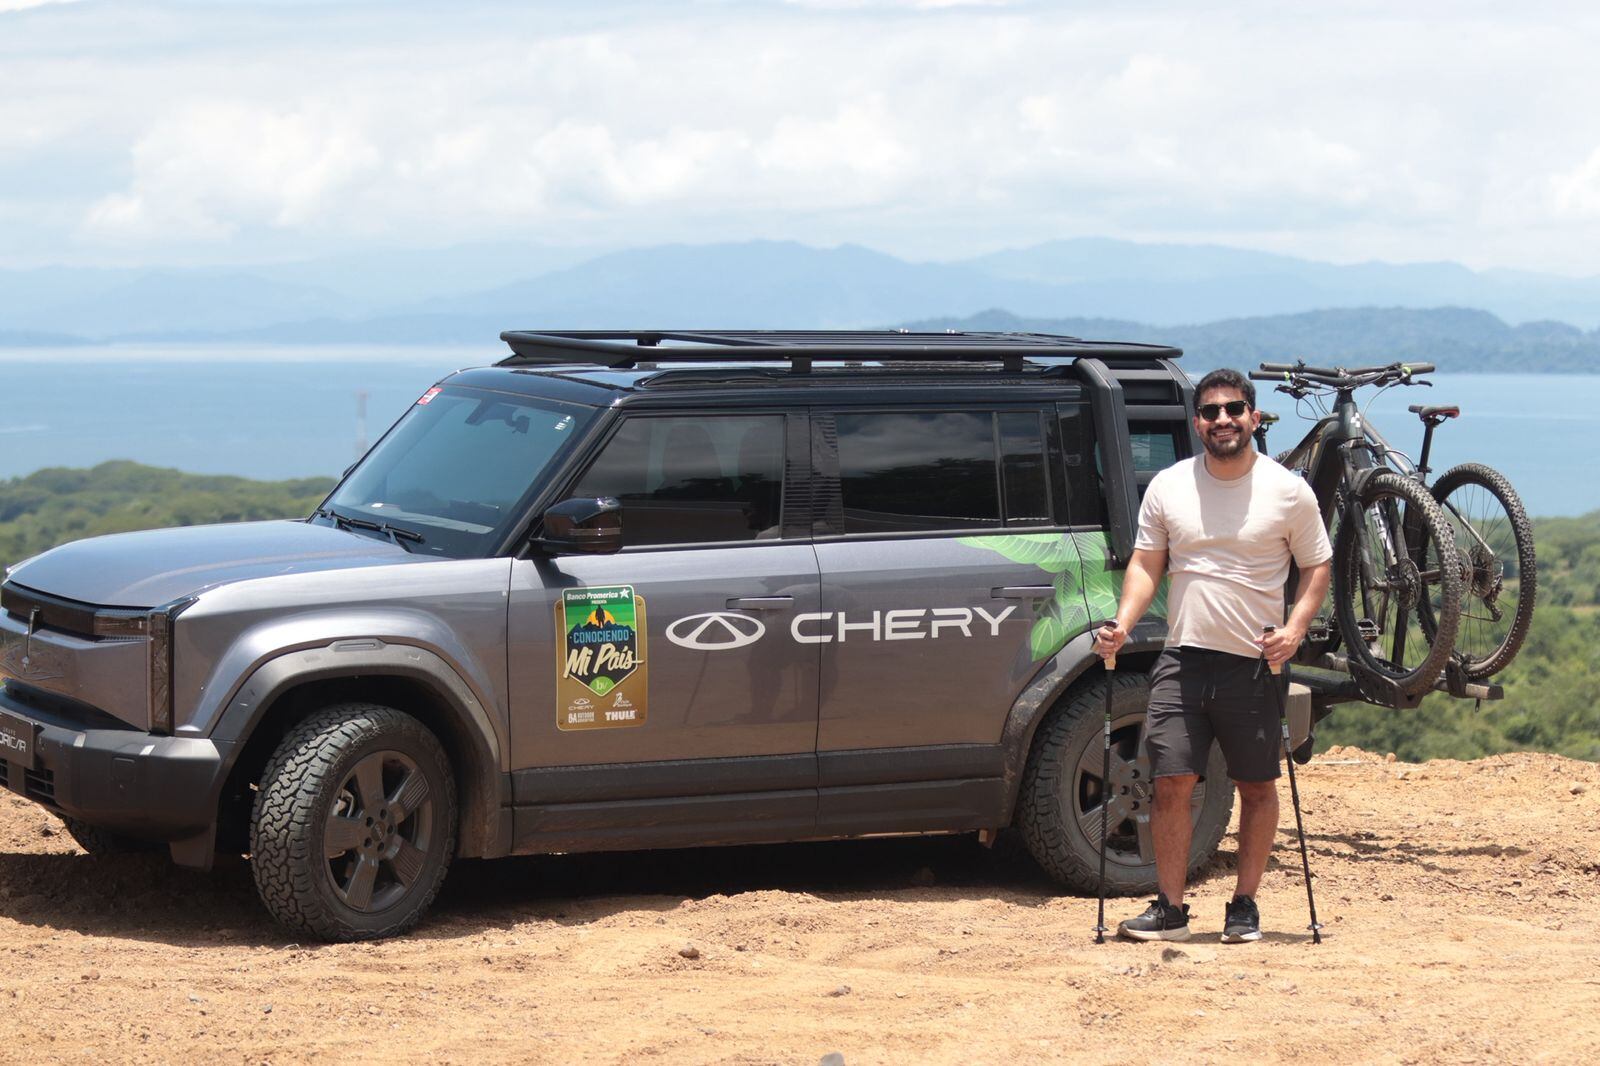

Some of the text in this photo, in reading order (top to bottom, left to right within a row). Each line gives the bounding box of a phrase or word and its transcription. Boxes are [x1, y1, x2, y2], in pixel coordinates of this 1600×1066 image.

[566, 591, 618, 601] Banco Promerica
[790, 606, 1017, 644] CHERY
[573, 629, 629, 644] CONOCIENDO
[563, 646, 593, 679] Mi
[605, 710, 635, 721] THULE
